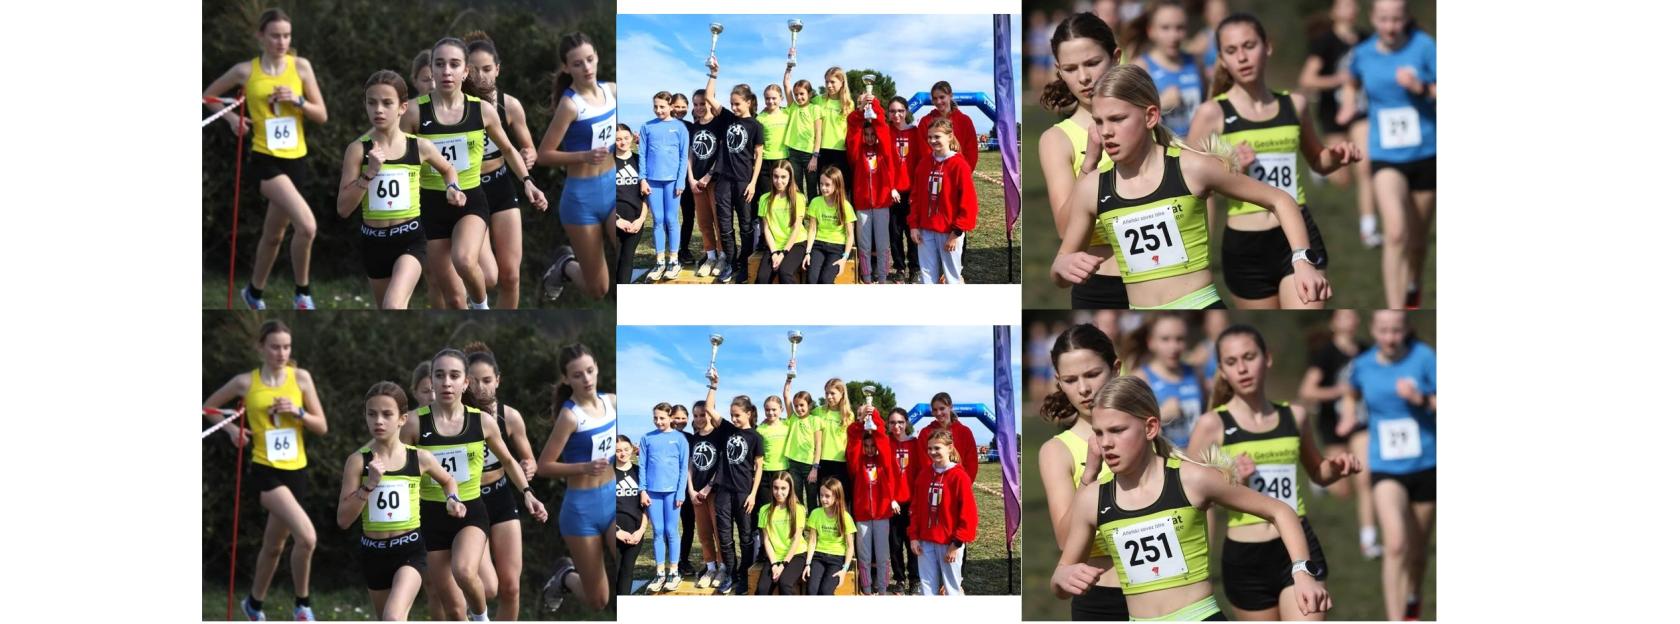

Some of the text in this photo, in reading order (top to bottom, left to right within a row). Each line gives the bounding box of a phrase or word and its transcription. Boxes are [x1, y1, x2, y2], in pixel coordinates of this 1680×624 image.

[274, 125, 290, 139] 66
[598, 125, 612, 141] 42
[441, 145, 457, 161] 61
[616, 176, 638, 186] dida
[1253, 165, 1292, 187] 248
[376, 179, 400, 199] 60
[361, 220, 419, 238] NIKE PRO
[1123, 221, 1173, 256] 251
[274, 436, 290, 450] 66
[598, 436, 612, 452] 42
[441, 456, 457, 472] 61
[616, 487, 638, 497] dida
[1253, 476, 1292, 498] 248
[376, 490, 400, 510] 60
[361, 531, 419, 549] NIKE PRO
[1123, 532, 1173, 567] 251
